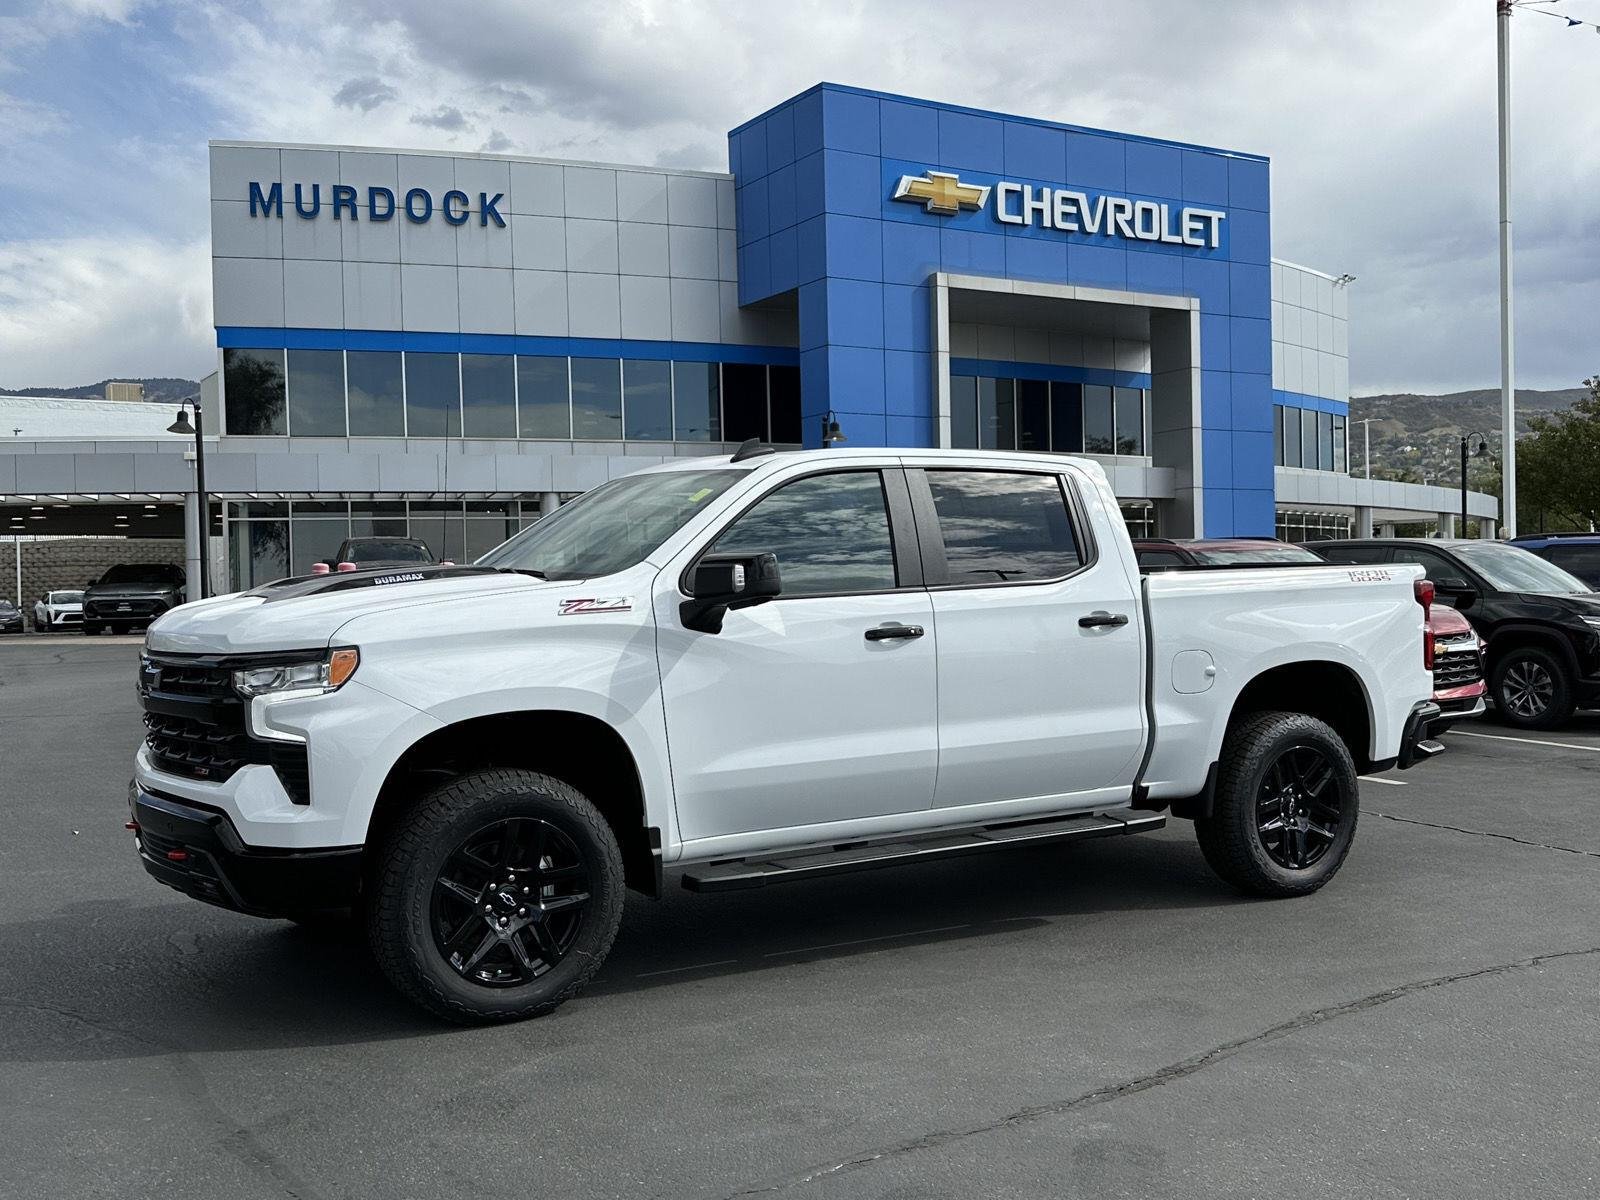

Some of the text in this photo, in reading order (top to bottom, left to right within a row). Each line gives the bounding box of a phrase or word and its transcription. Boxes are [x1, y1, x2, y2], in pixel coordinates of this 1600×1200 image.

[249, 181, 507, 228] MURDOCK
[996, 181, 1226, 249] CHEVROLET
[373, 572, 425, 585] DURAMAX
